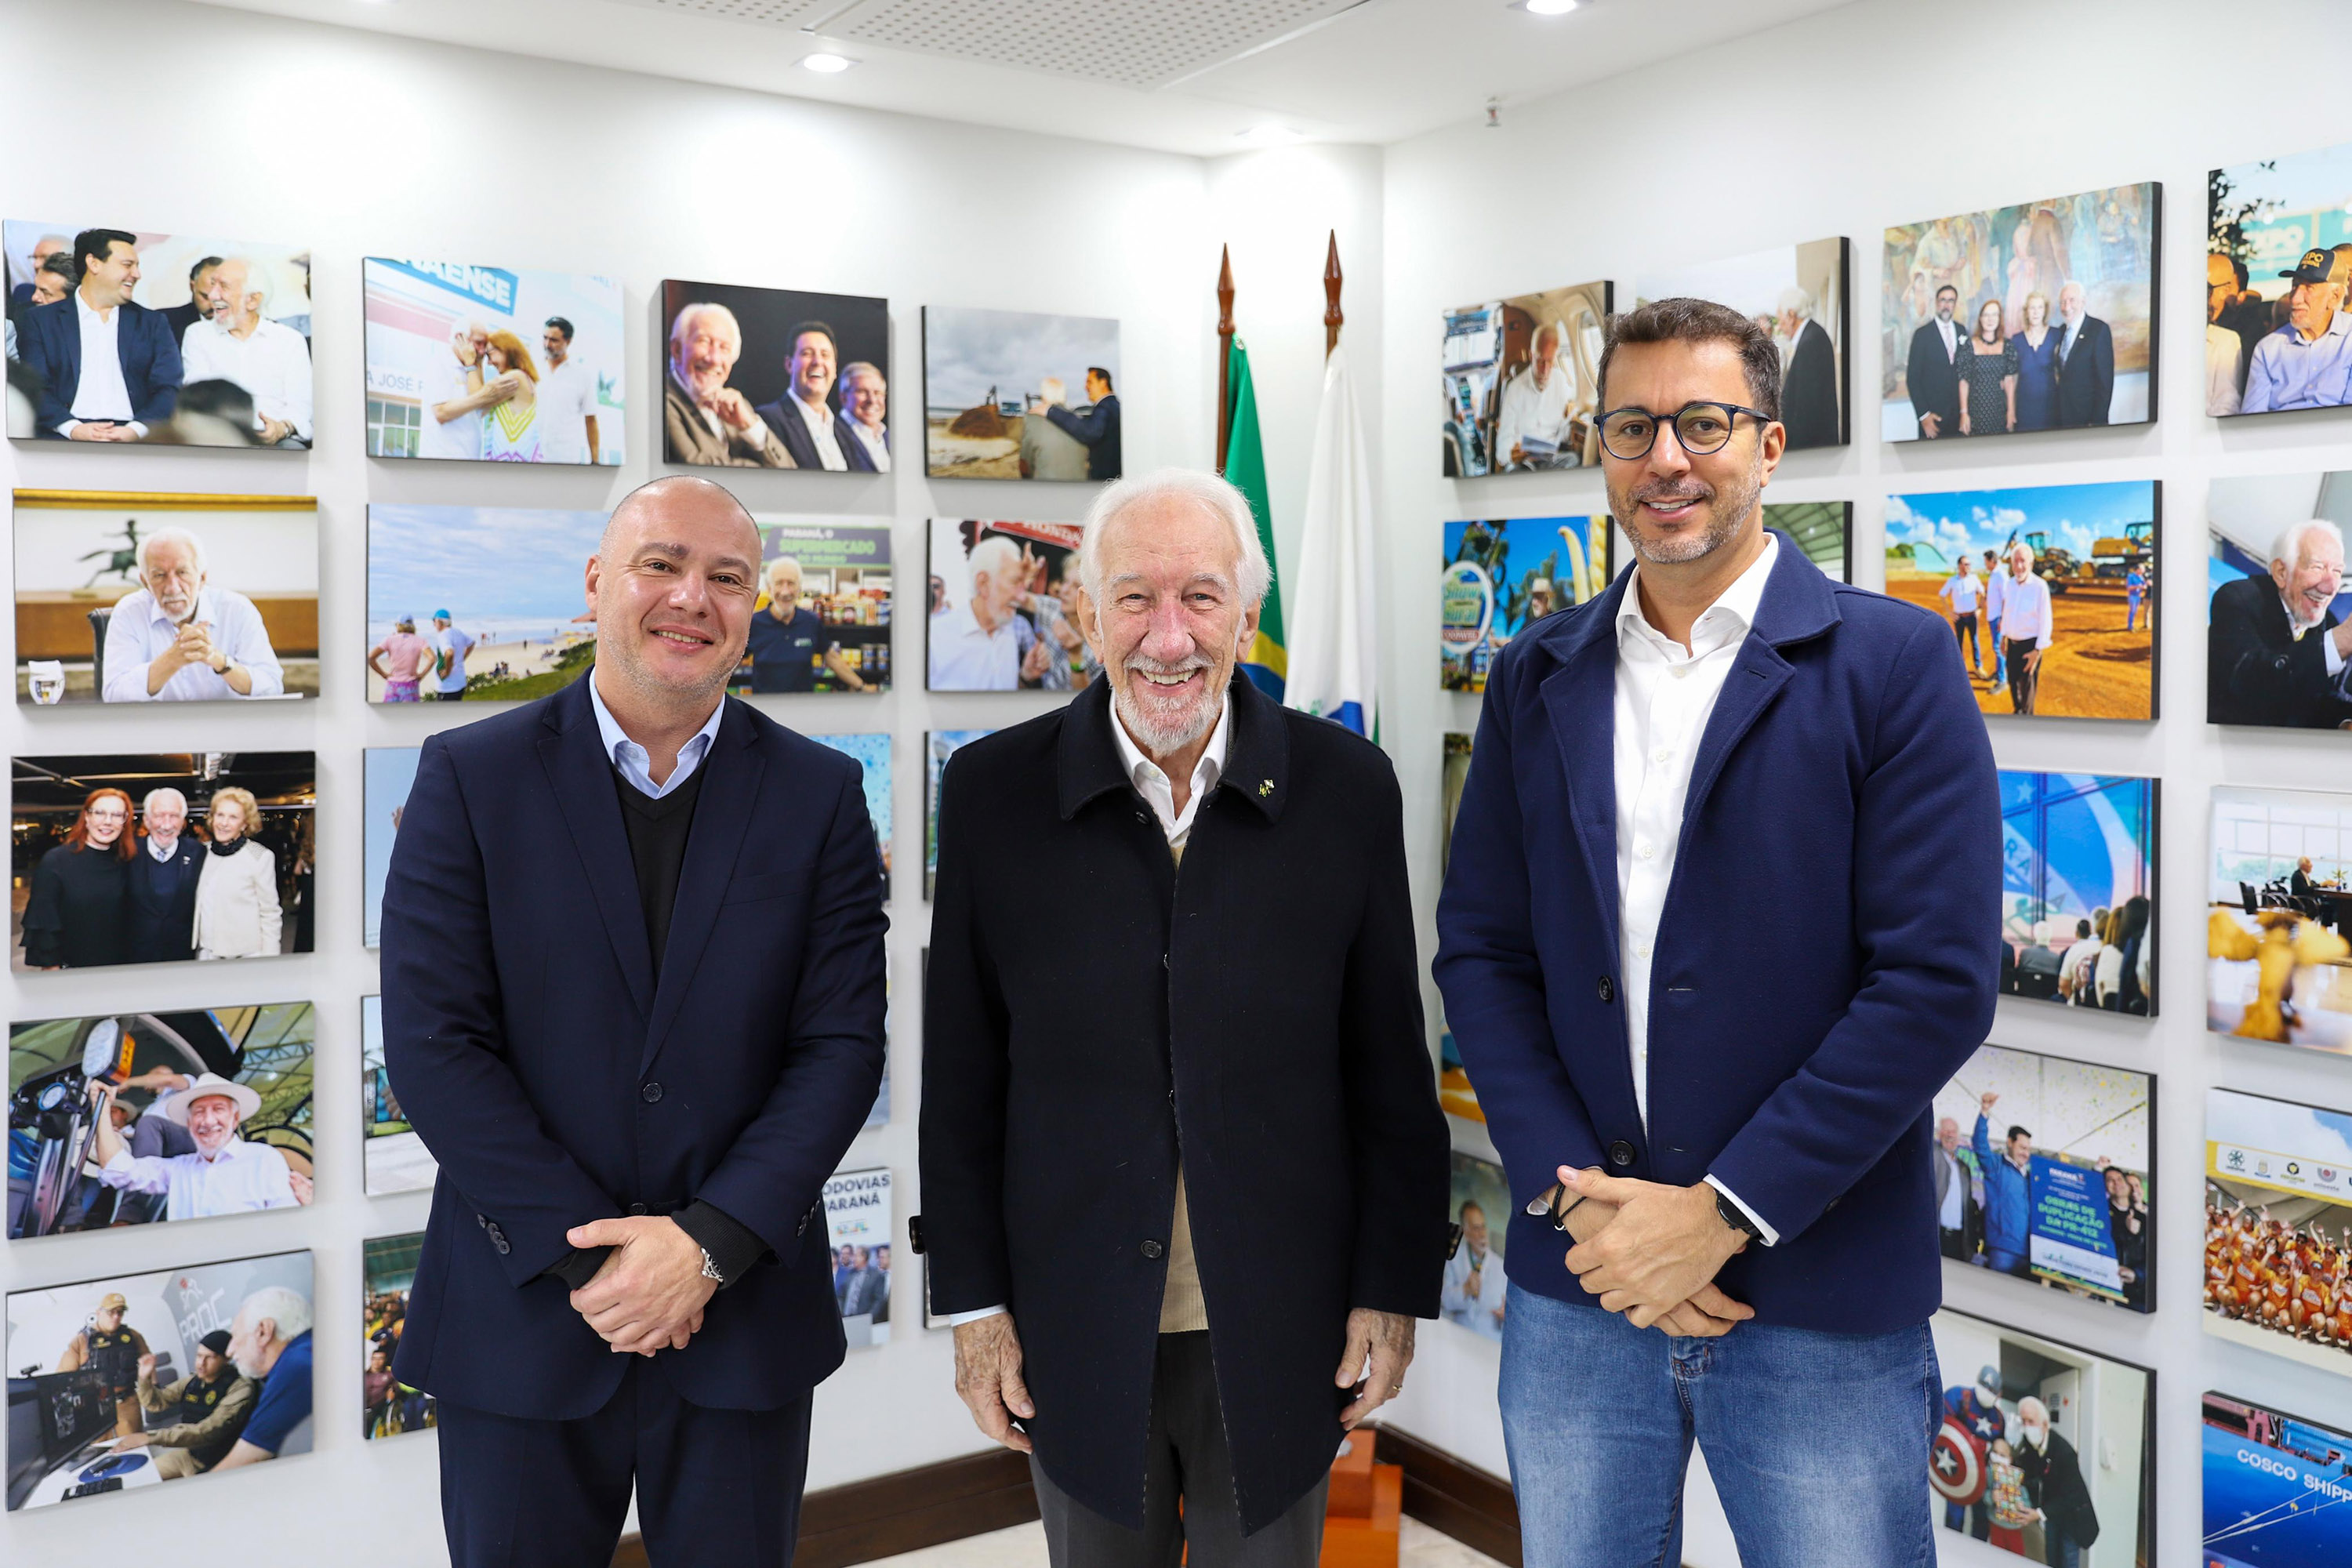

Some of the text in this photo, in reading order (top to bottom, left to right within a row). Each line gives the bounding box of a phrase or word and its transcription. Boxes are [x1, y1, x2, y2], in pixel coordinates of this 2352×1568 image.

[379, 372, 413, 391] JOSÉ
[779, 539, 877, 556] SUPERMERCADO
[2238, 1449, 2297, 1481] COSCO
